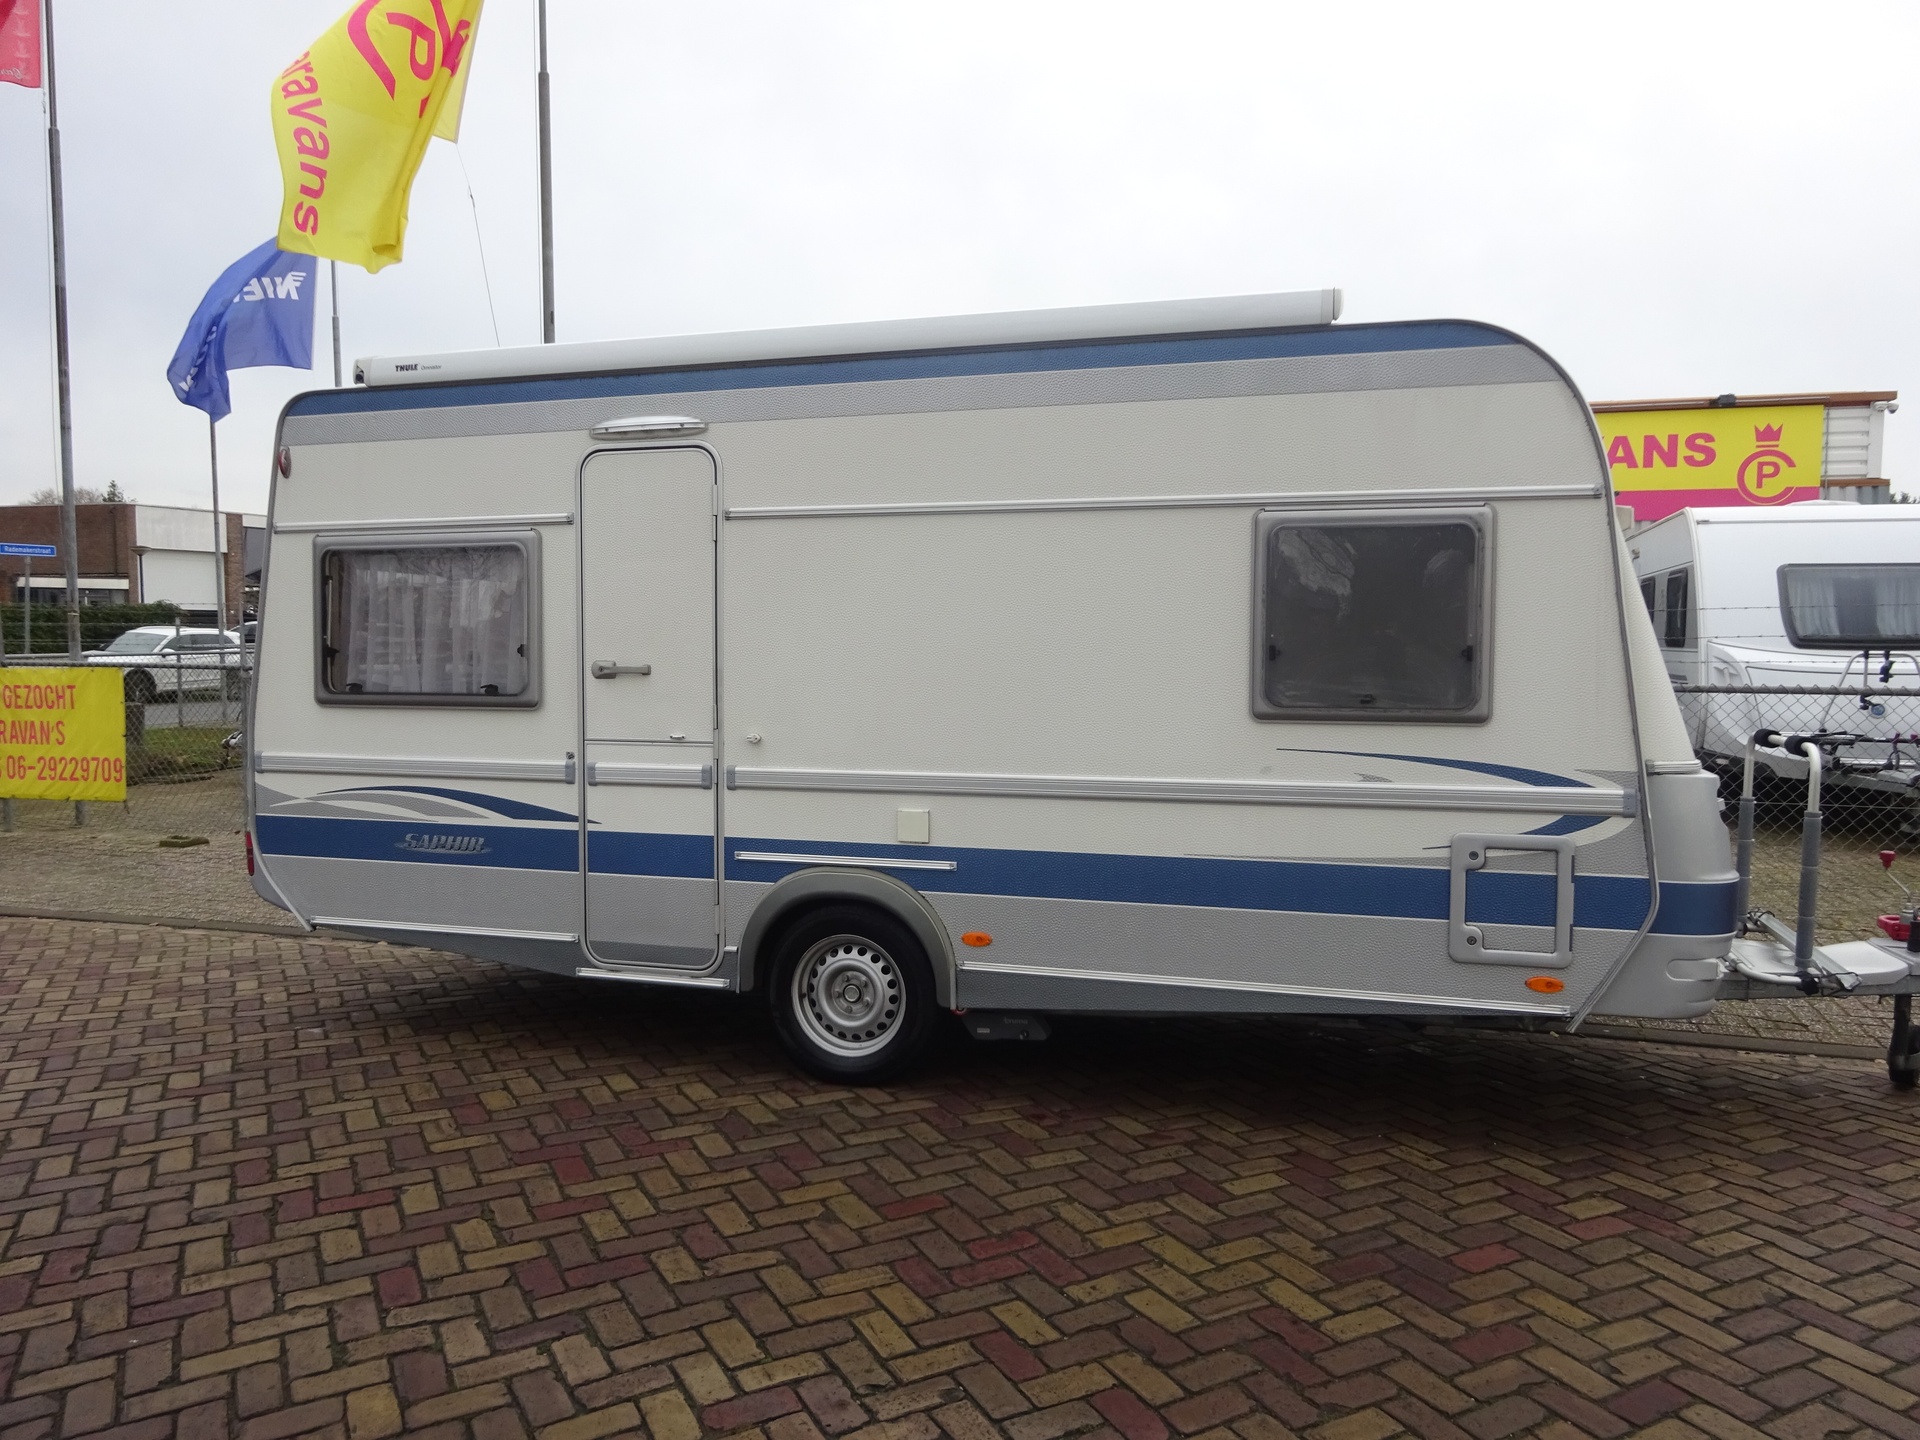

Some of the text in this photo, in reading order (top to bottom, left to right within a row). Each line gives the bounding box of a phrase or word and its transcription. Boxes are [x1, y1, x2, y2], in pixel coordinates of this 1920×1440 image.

[395, 363, 418, 371] THULE
[1602, 432, 1717, 469] ANS
[3, 684, 76, 710] GEZOCHT
[6, 755, 123, 783] 06-29229709
[404, 833, 485, 852] SAPHIR
